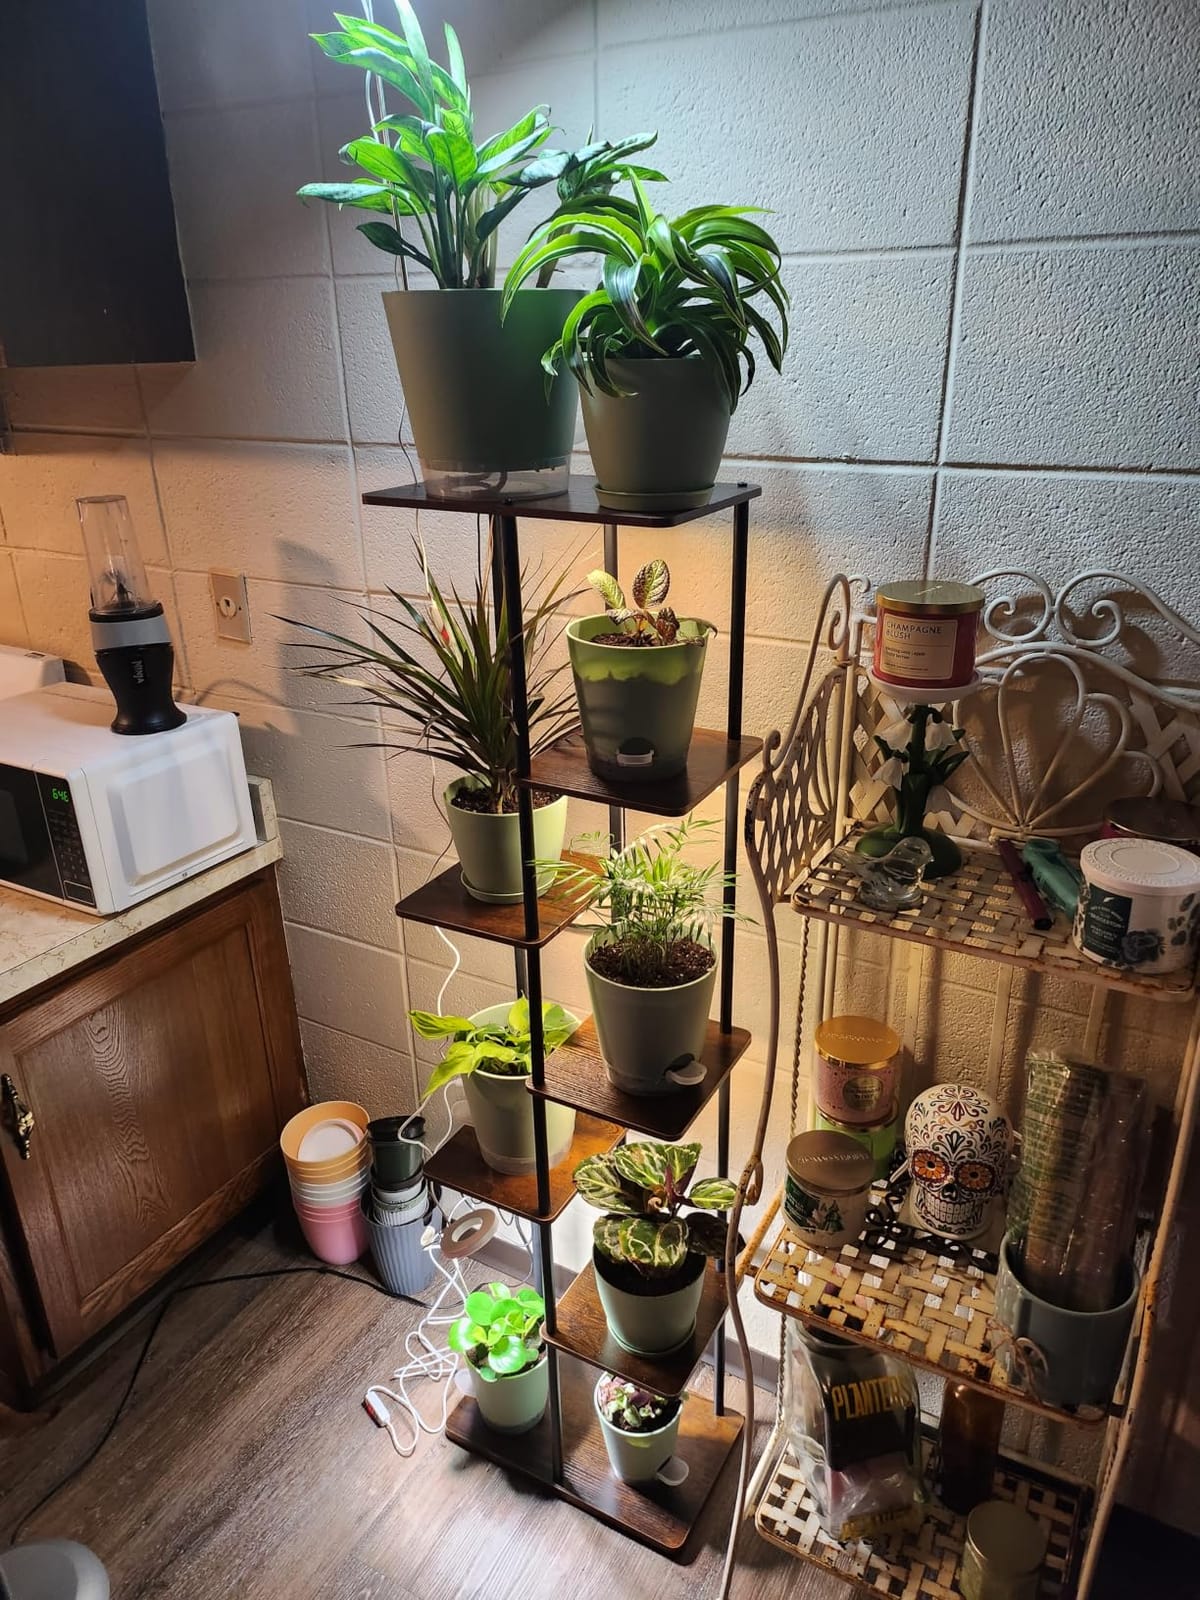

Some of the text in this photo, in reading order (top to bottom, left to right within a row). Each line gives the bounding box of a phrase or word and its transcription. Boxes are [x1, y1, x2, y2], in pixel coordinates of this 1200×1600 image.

[886, 621, 942, 634] CHAMPAGNE
[886, 629, 911, 640] BLUSH
[831, 1376, 914, 1422] PLANTERS
